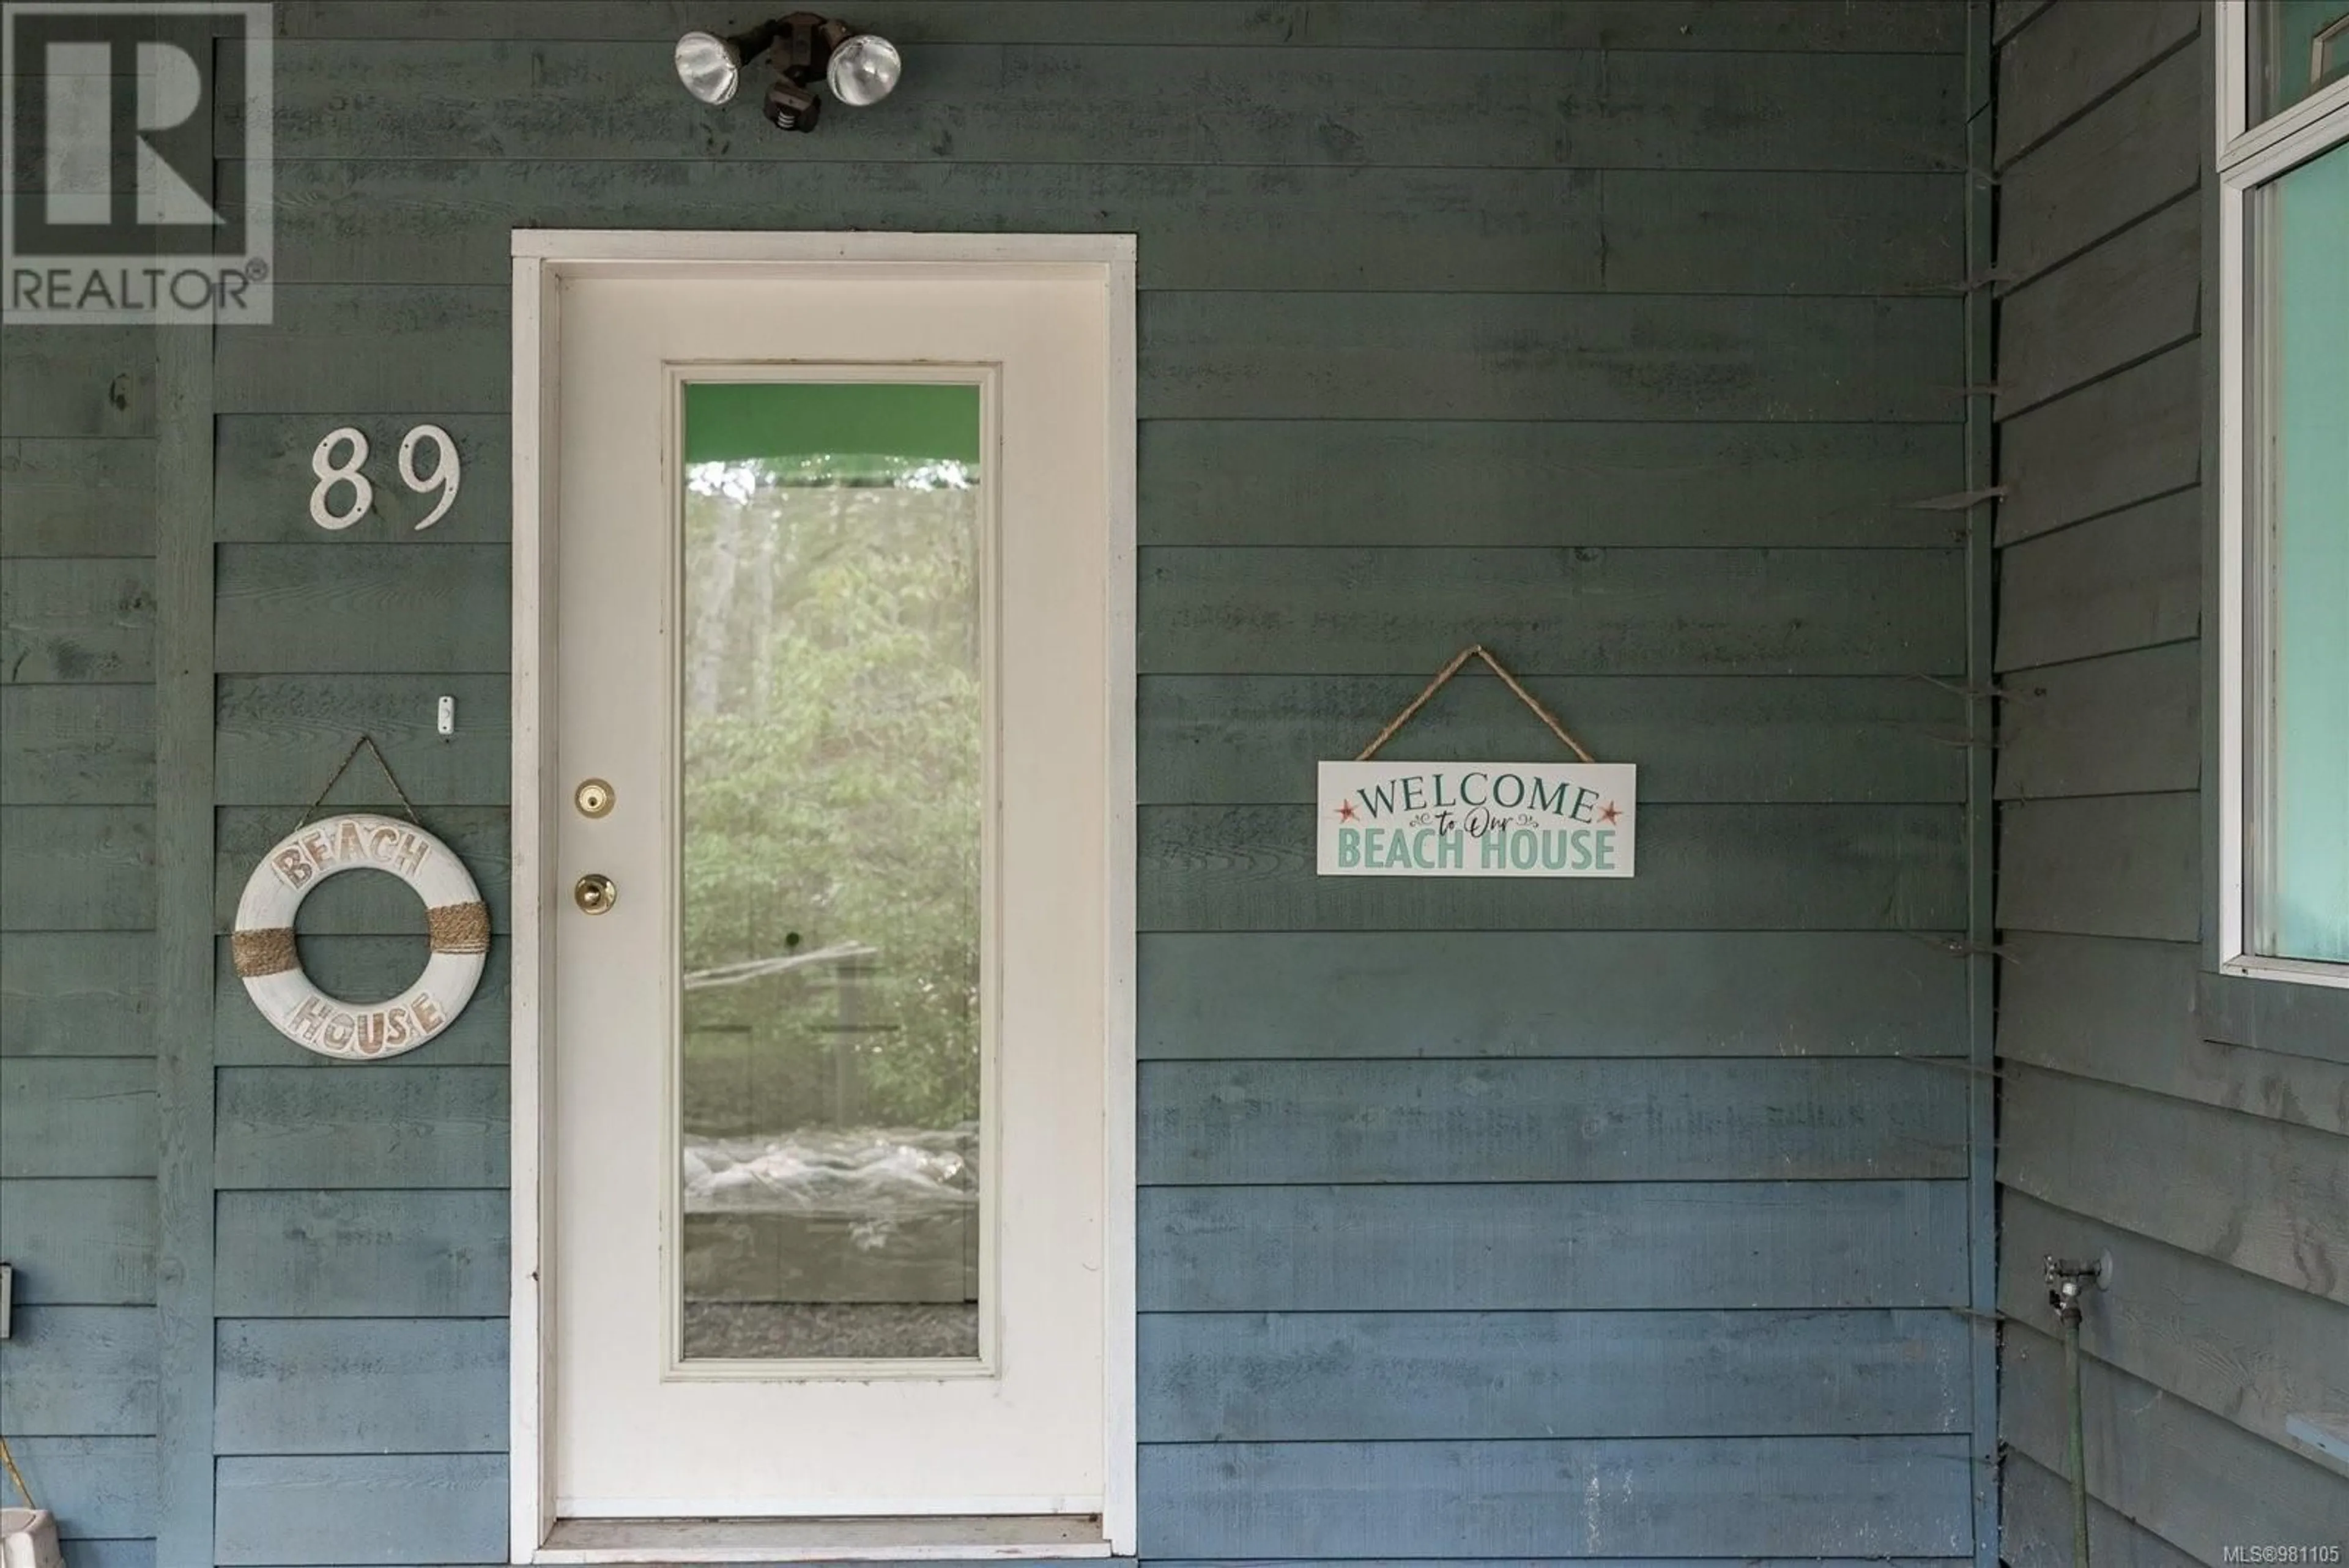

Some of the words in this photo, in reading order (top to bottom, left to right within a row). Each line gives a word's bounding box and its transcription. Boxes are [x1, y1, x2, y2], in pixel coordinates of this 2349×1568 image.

[310, 424, 461, 530] 89
[1357, 772, 1600, 823] WELCOME
[1435, 810, 1455, 836] to
[1464, 806, 1515, 838] Our
[274, 821, 429, 888] BEACH
[1338, 828, 1463, 869] BEACH
[1481, 829, 1616, 870] HOUSE
[289, 994, 447, 1055] HOUSE
